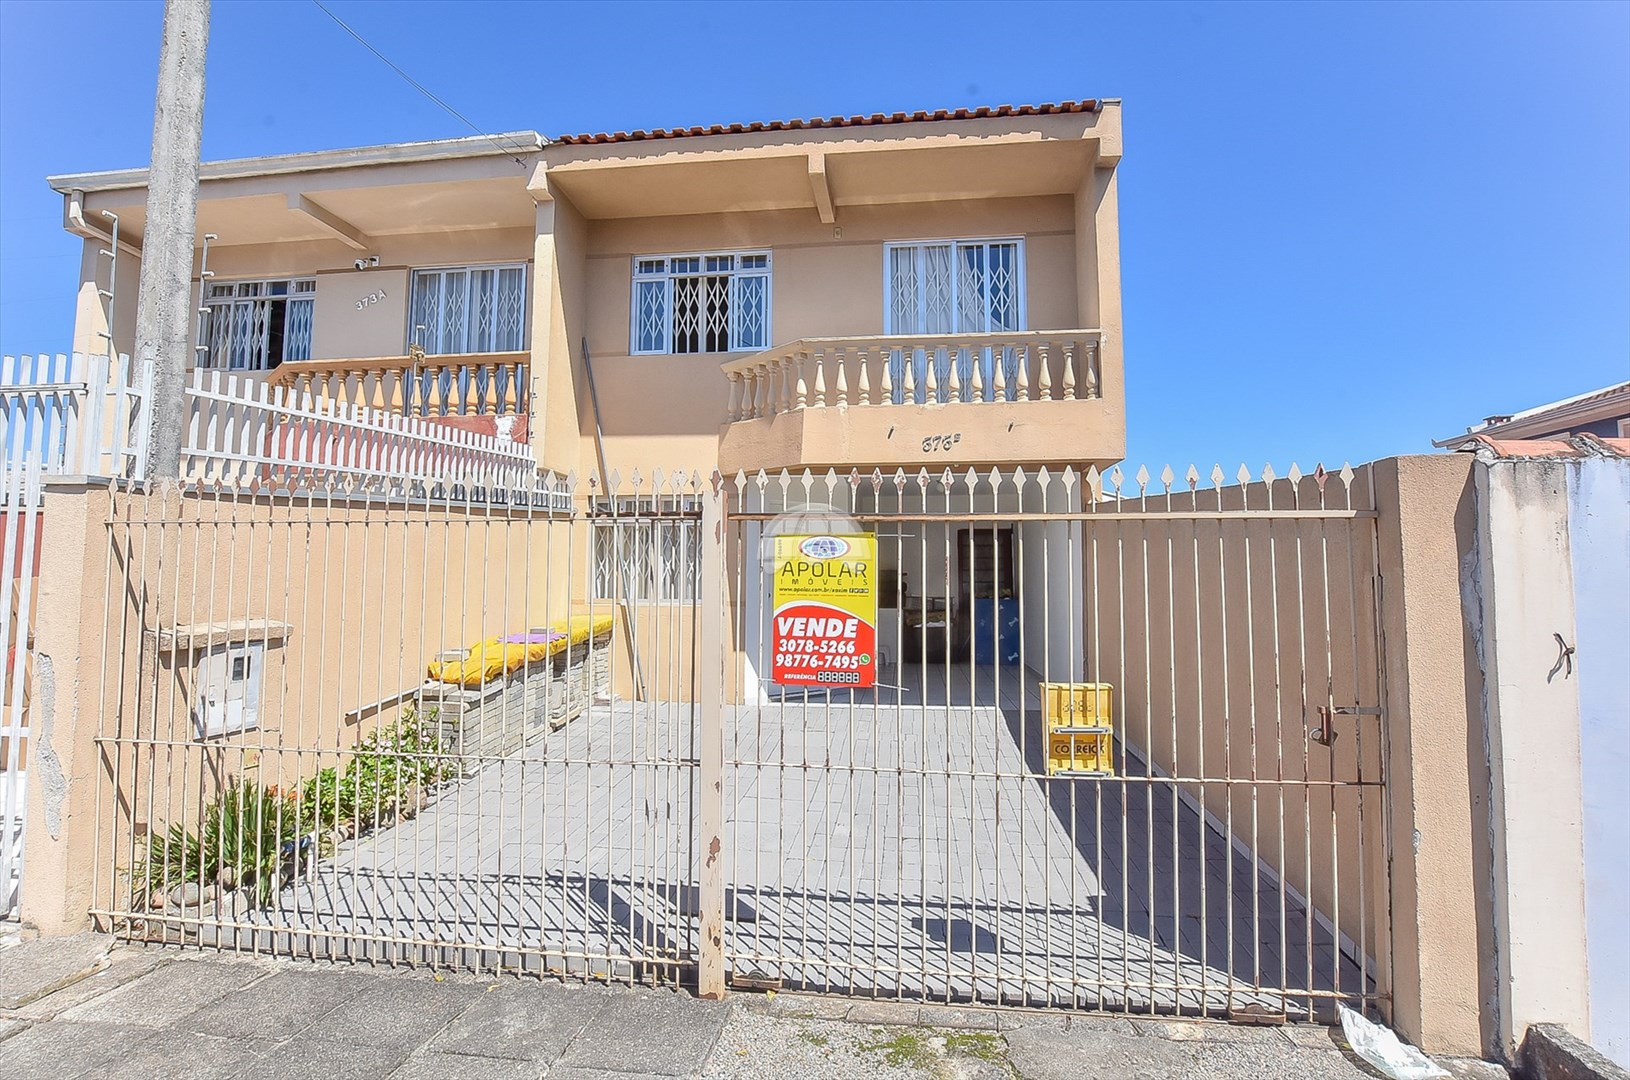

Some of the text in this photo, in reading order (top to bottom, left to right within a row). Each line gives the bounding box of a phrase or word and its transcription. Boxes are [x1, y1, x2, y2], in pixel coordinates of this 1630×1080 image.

[355, 289, 387, 311] 373A
[781, 561, 867, 578] APOLAR
[780, 578, 868, 586] IMÓVEIS
[777, 617, 859, 638] VENDE
[778, 639, 856, 654] 3078-5266
[775, 654, 859, 669] 98776-7495
[1055, 744, 1105, 754] COREIO
